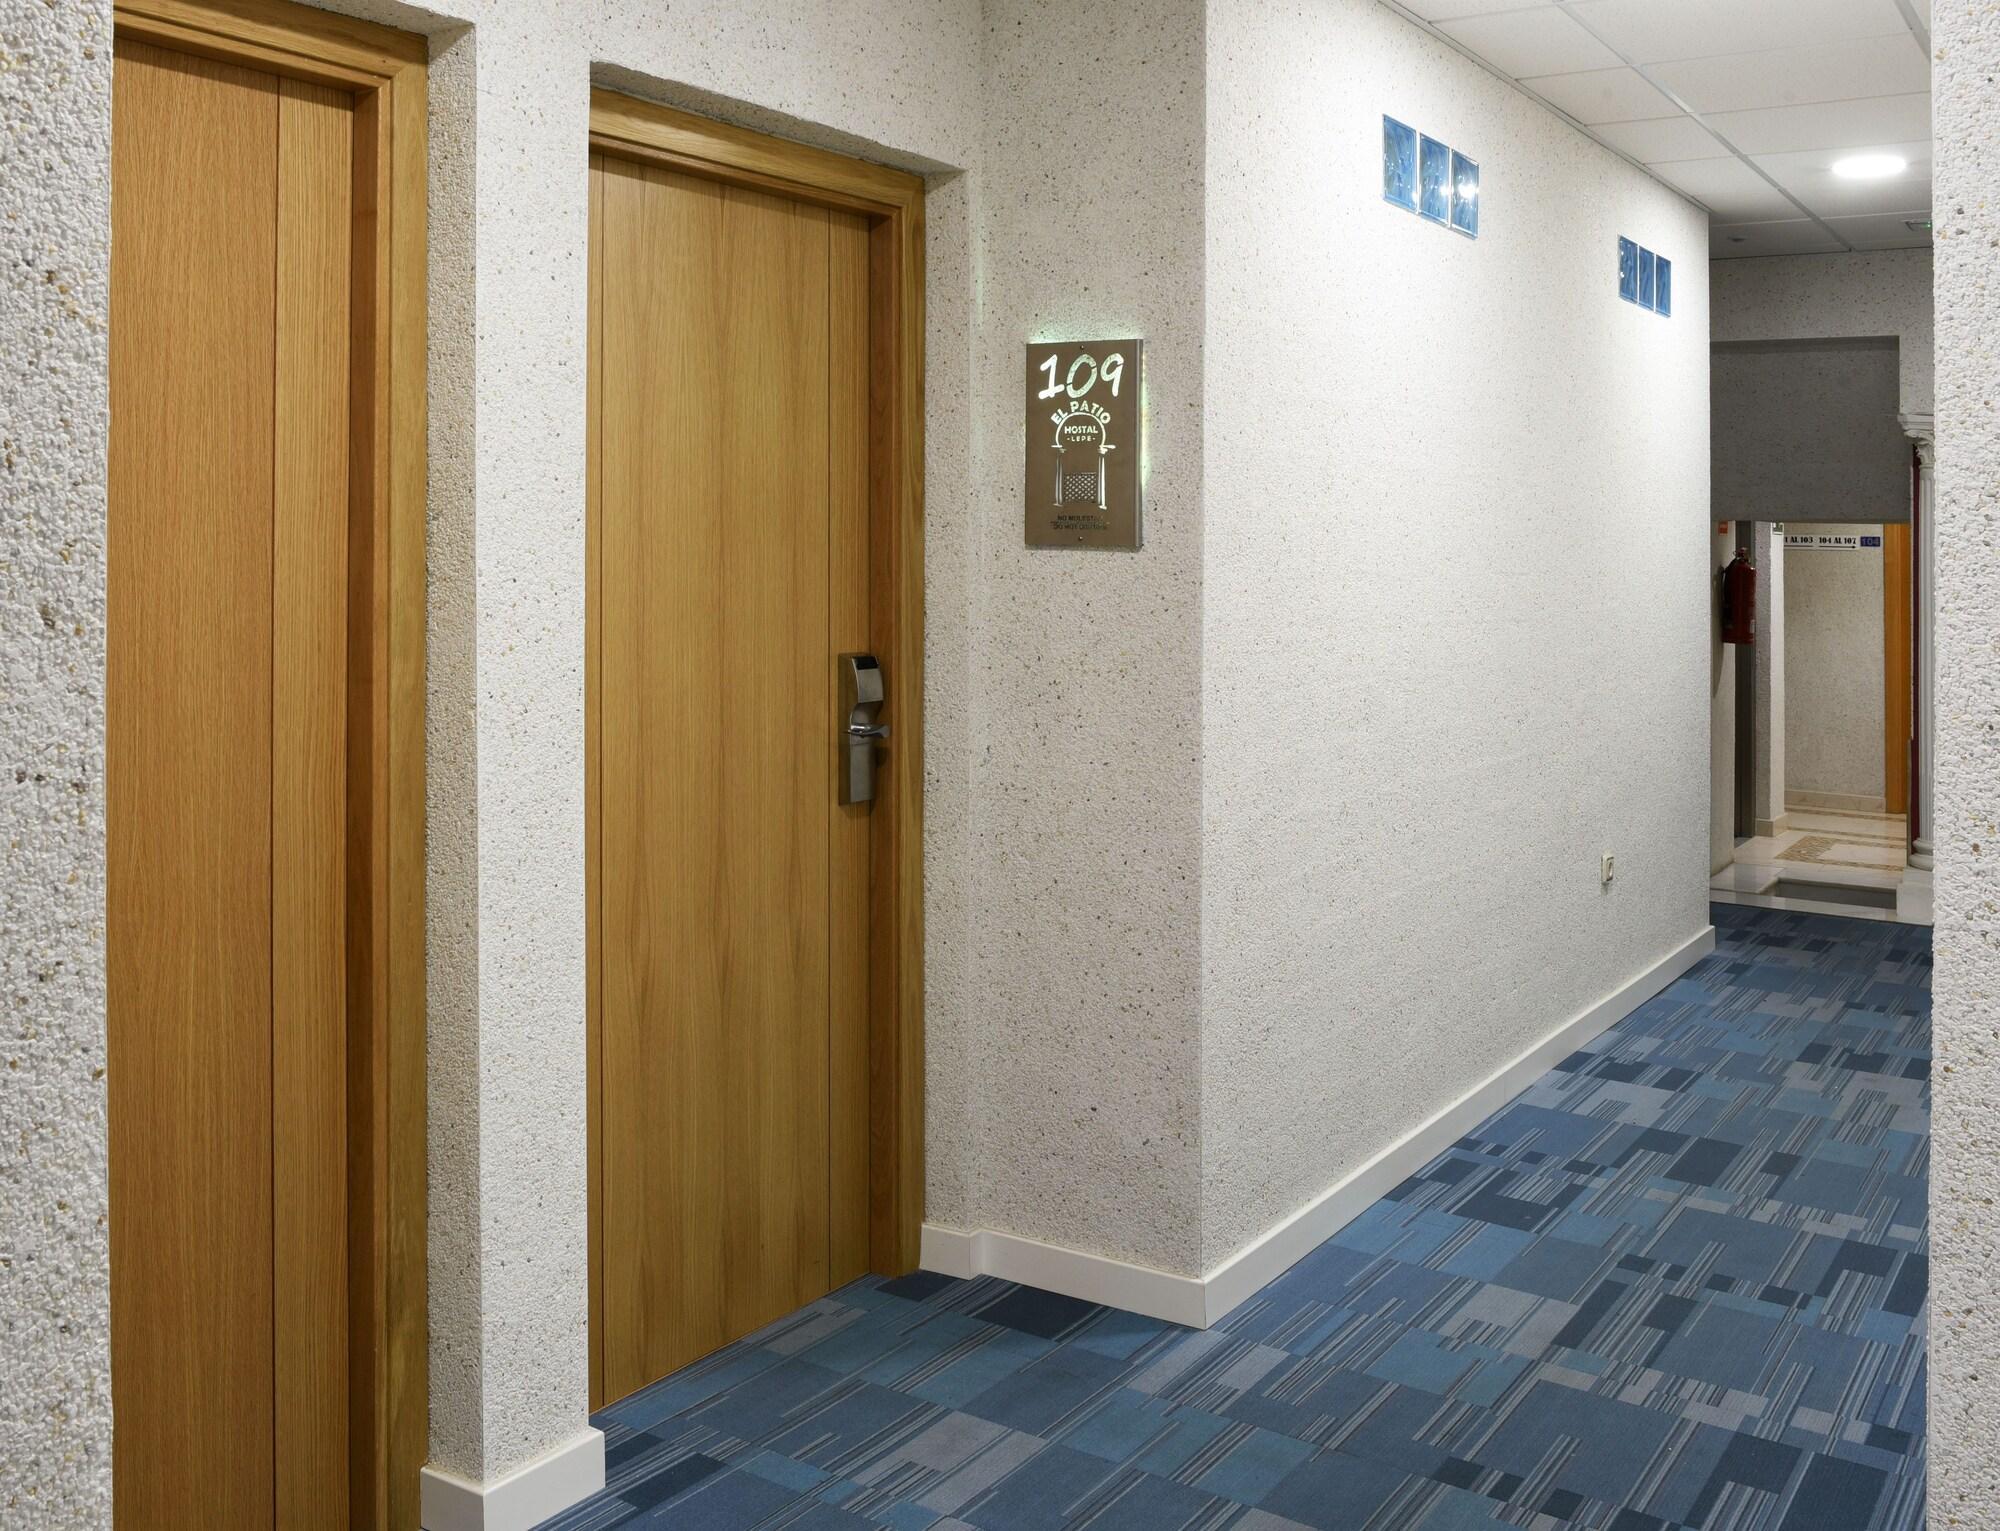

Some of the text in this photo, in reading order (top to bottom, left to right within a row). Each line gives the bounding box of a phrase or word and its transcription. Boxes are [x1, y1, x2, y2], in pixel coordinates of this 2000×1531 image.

[1038, 353, 1124, 399] 109
[1050, 400, 1111, 425] EL PATIO
[1064, 425, 1098, 434] HOSTAL
[1800, 536, 1813, 544] 103
[1834, 536, 1842, 544] AL
[1863, 537, 1880, 546] 104
